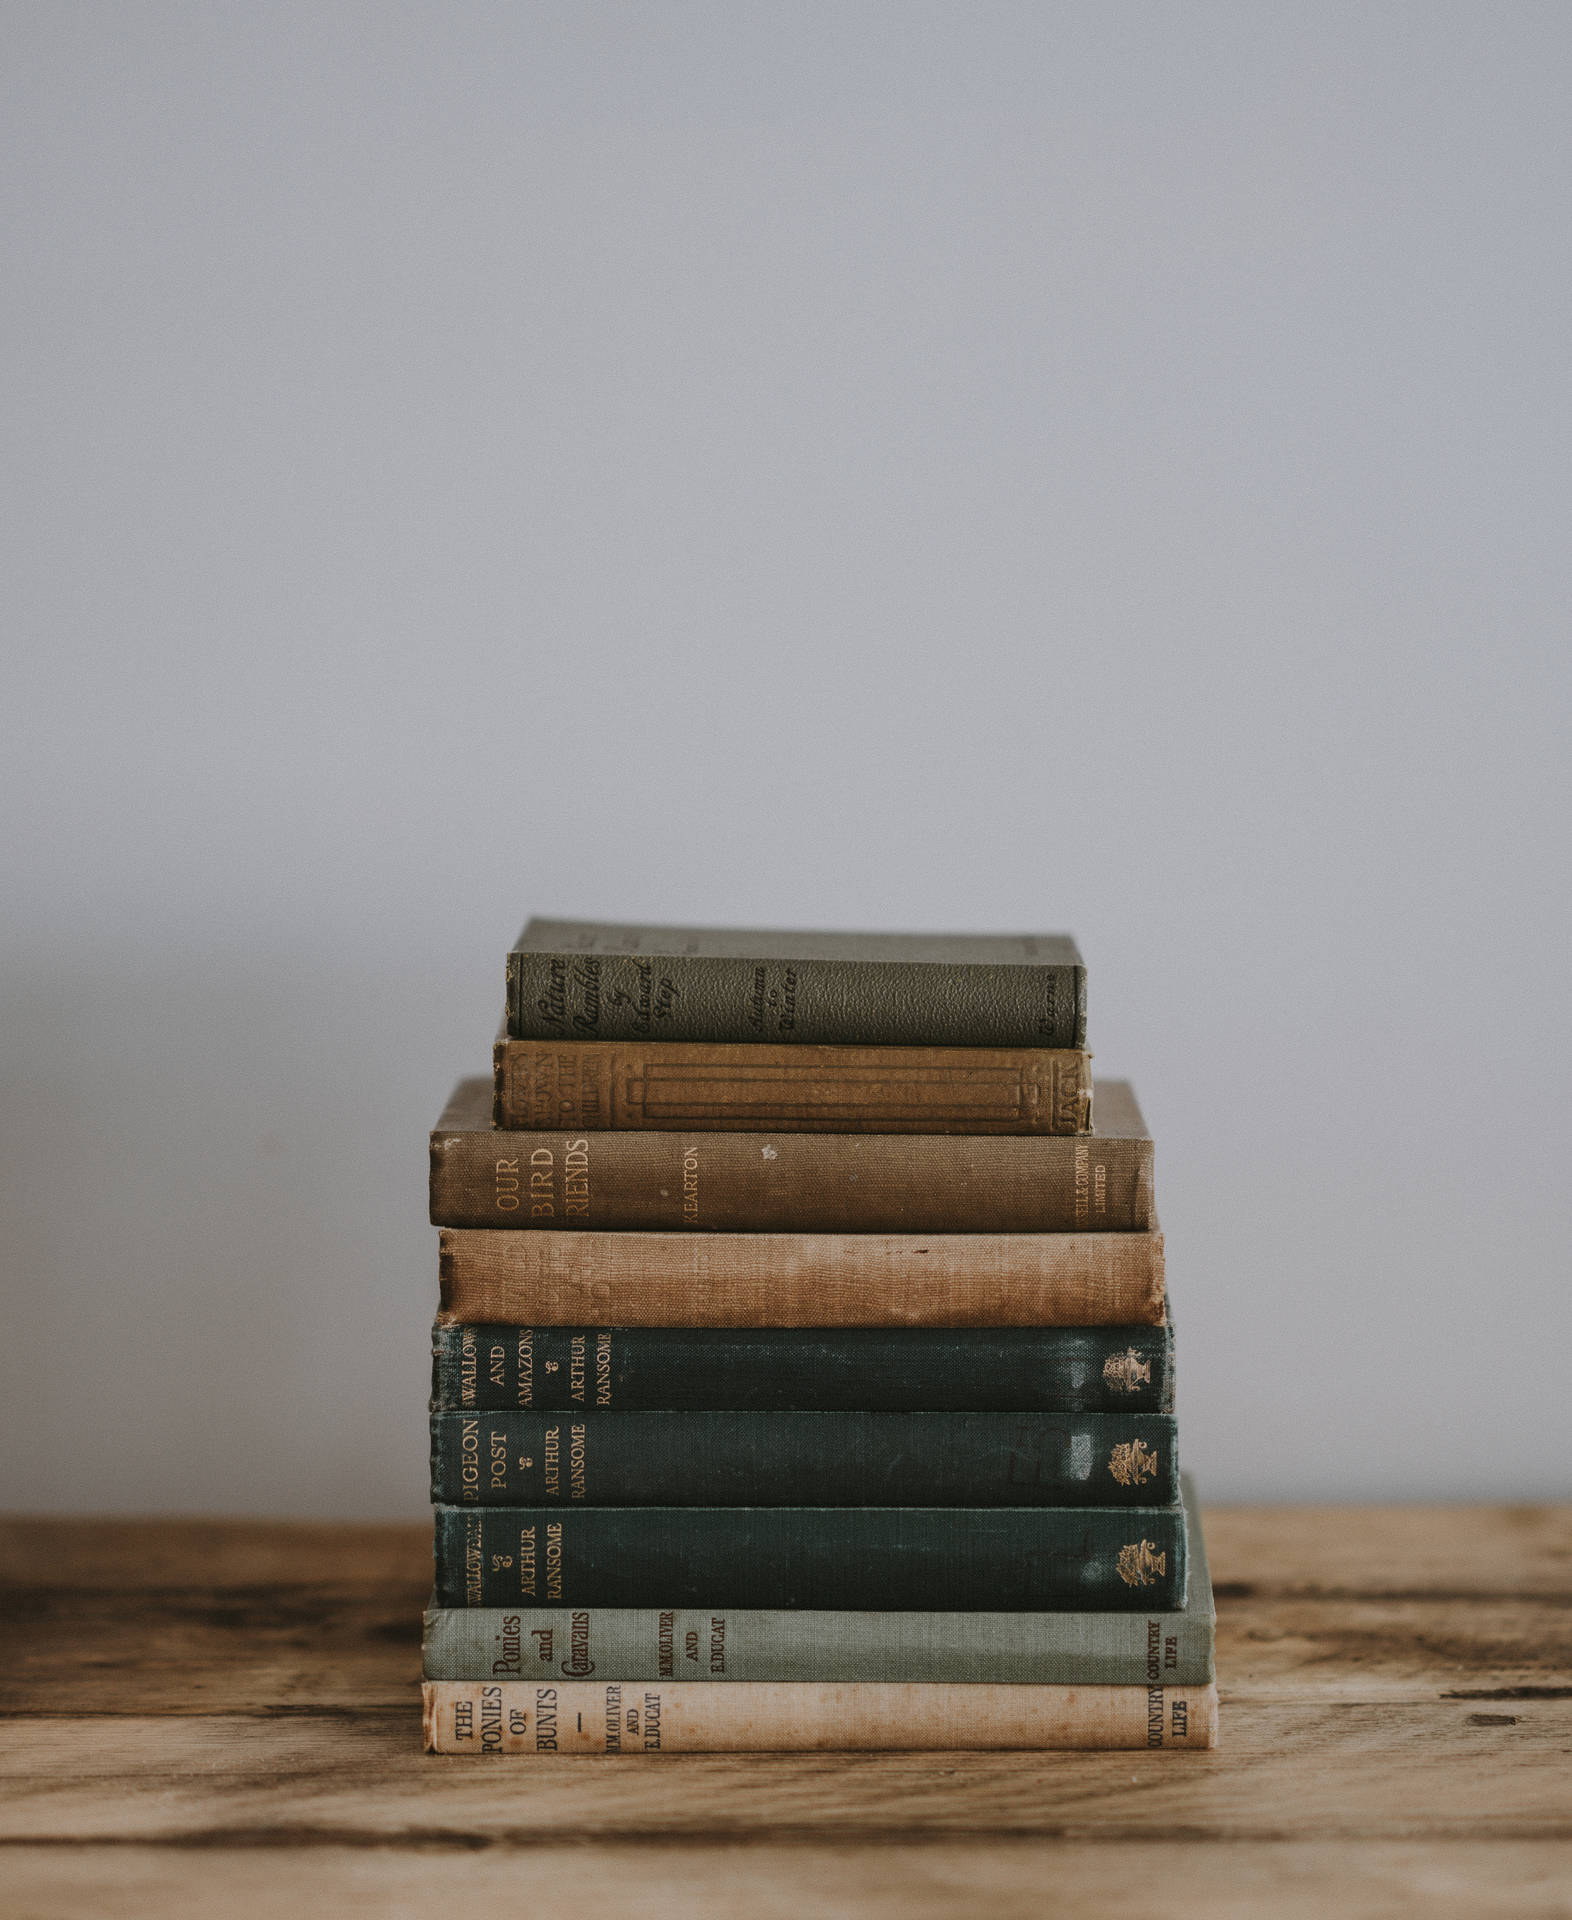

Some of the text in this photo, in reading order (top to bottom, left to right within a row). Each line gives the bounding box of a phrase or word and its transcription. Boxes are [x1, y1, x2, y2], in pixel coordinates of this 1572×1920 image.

[538, 958, 566, 1035] Nature
[572, 957, 600, 1037] Rambles
[632, 957, 653, 1034] Edward
[496, 1156, 520, 1211] OUR
[530, 1148, 554, 1217] BIRD
[565, 1138, 590, 1218] RIENDS
[683, 1146, 699, 1225] KEARTON
[1074, 1143, 1089, 1186] COMPANY
[1094, 1164, 1107, 1214] LIMITED
[490, 1345, 505, 1387] AND
[518, 1328, 534, 1408] AMAZONS
[570, 1335, 586, 1402] ARTHUR
[596, 1332, 612, 1406] RANSOME
[462, 1418, 480, 1501] PIGEON
[490, 1431, 507, 1489] POST
[545, 1425, 560, 1497] ARTHUR
[570, 1423, 586, 1499] RANSOME
[521, 1525, 537, 1597] ARTHUR
[546, 1522, 563, 1600] RANSOME
[492, 1615, 522, 1675] Ponies
[531, 1628, 553, 1663] and
[560, 1611, 596, 1678] Caravans
[685, 1631, 699, 1662] AND
[1147, 1619, 1161, 1681] COUNTRY
[1164, 1636, 1178, 1669] LIFE
[455, 1700, 473, 1741] THE
[481, 1686, 503, 1753] PONIES
[509, 1708, 527, 1736] OF
[536, 1687, 558, 1752] BUNTS
[626, 1708, 640, 1736] AND
[1147, 1686, 1164, 1748] COUNTRY
[1171, 1700, 1187, 1737] LIFE
